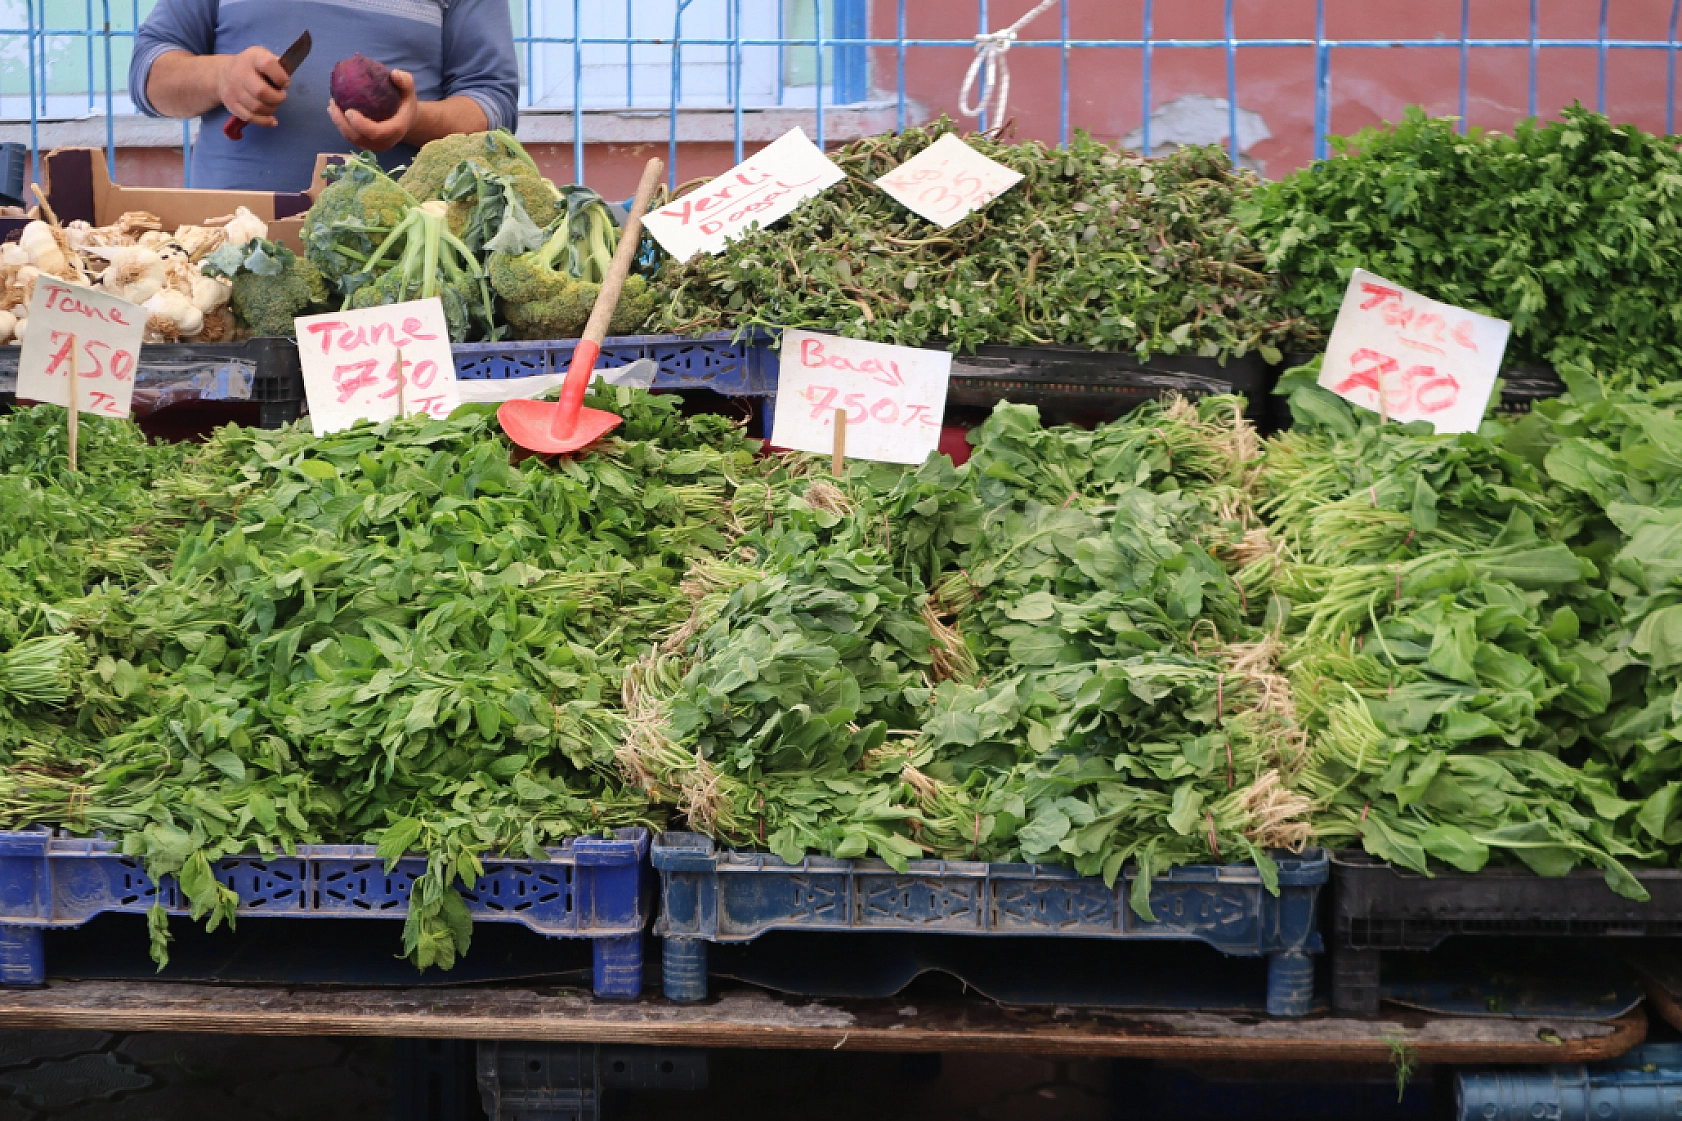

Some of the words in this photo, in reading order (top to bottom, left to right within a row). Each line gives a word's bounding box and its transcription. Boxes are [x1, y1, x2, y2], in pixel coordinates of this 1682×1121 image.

[43, 285, 130, 326] Tane
[1359, 281, 1479, 353] Tane
[306, 317, 438, 355] Tane
